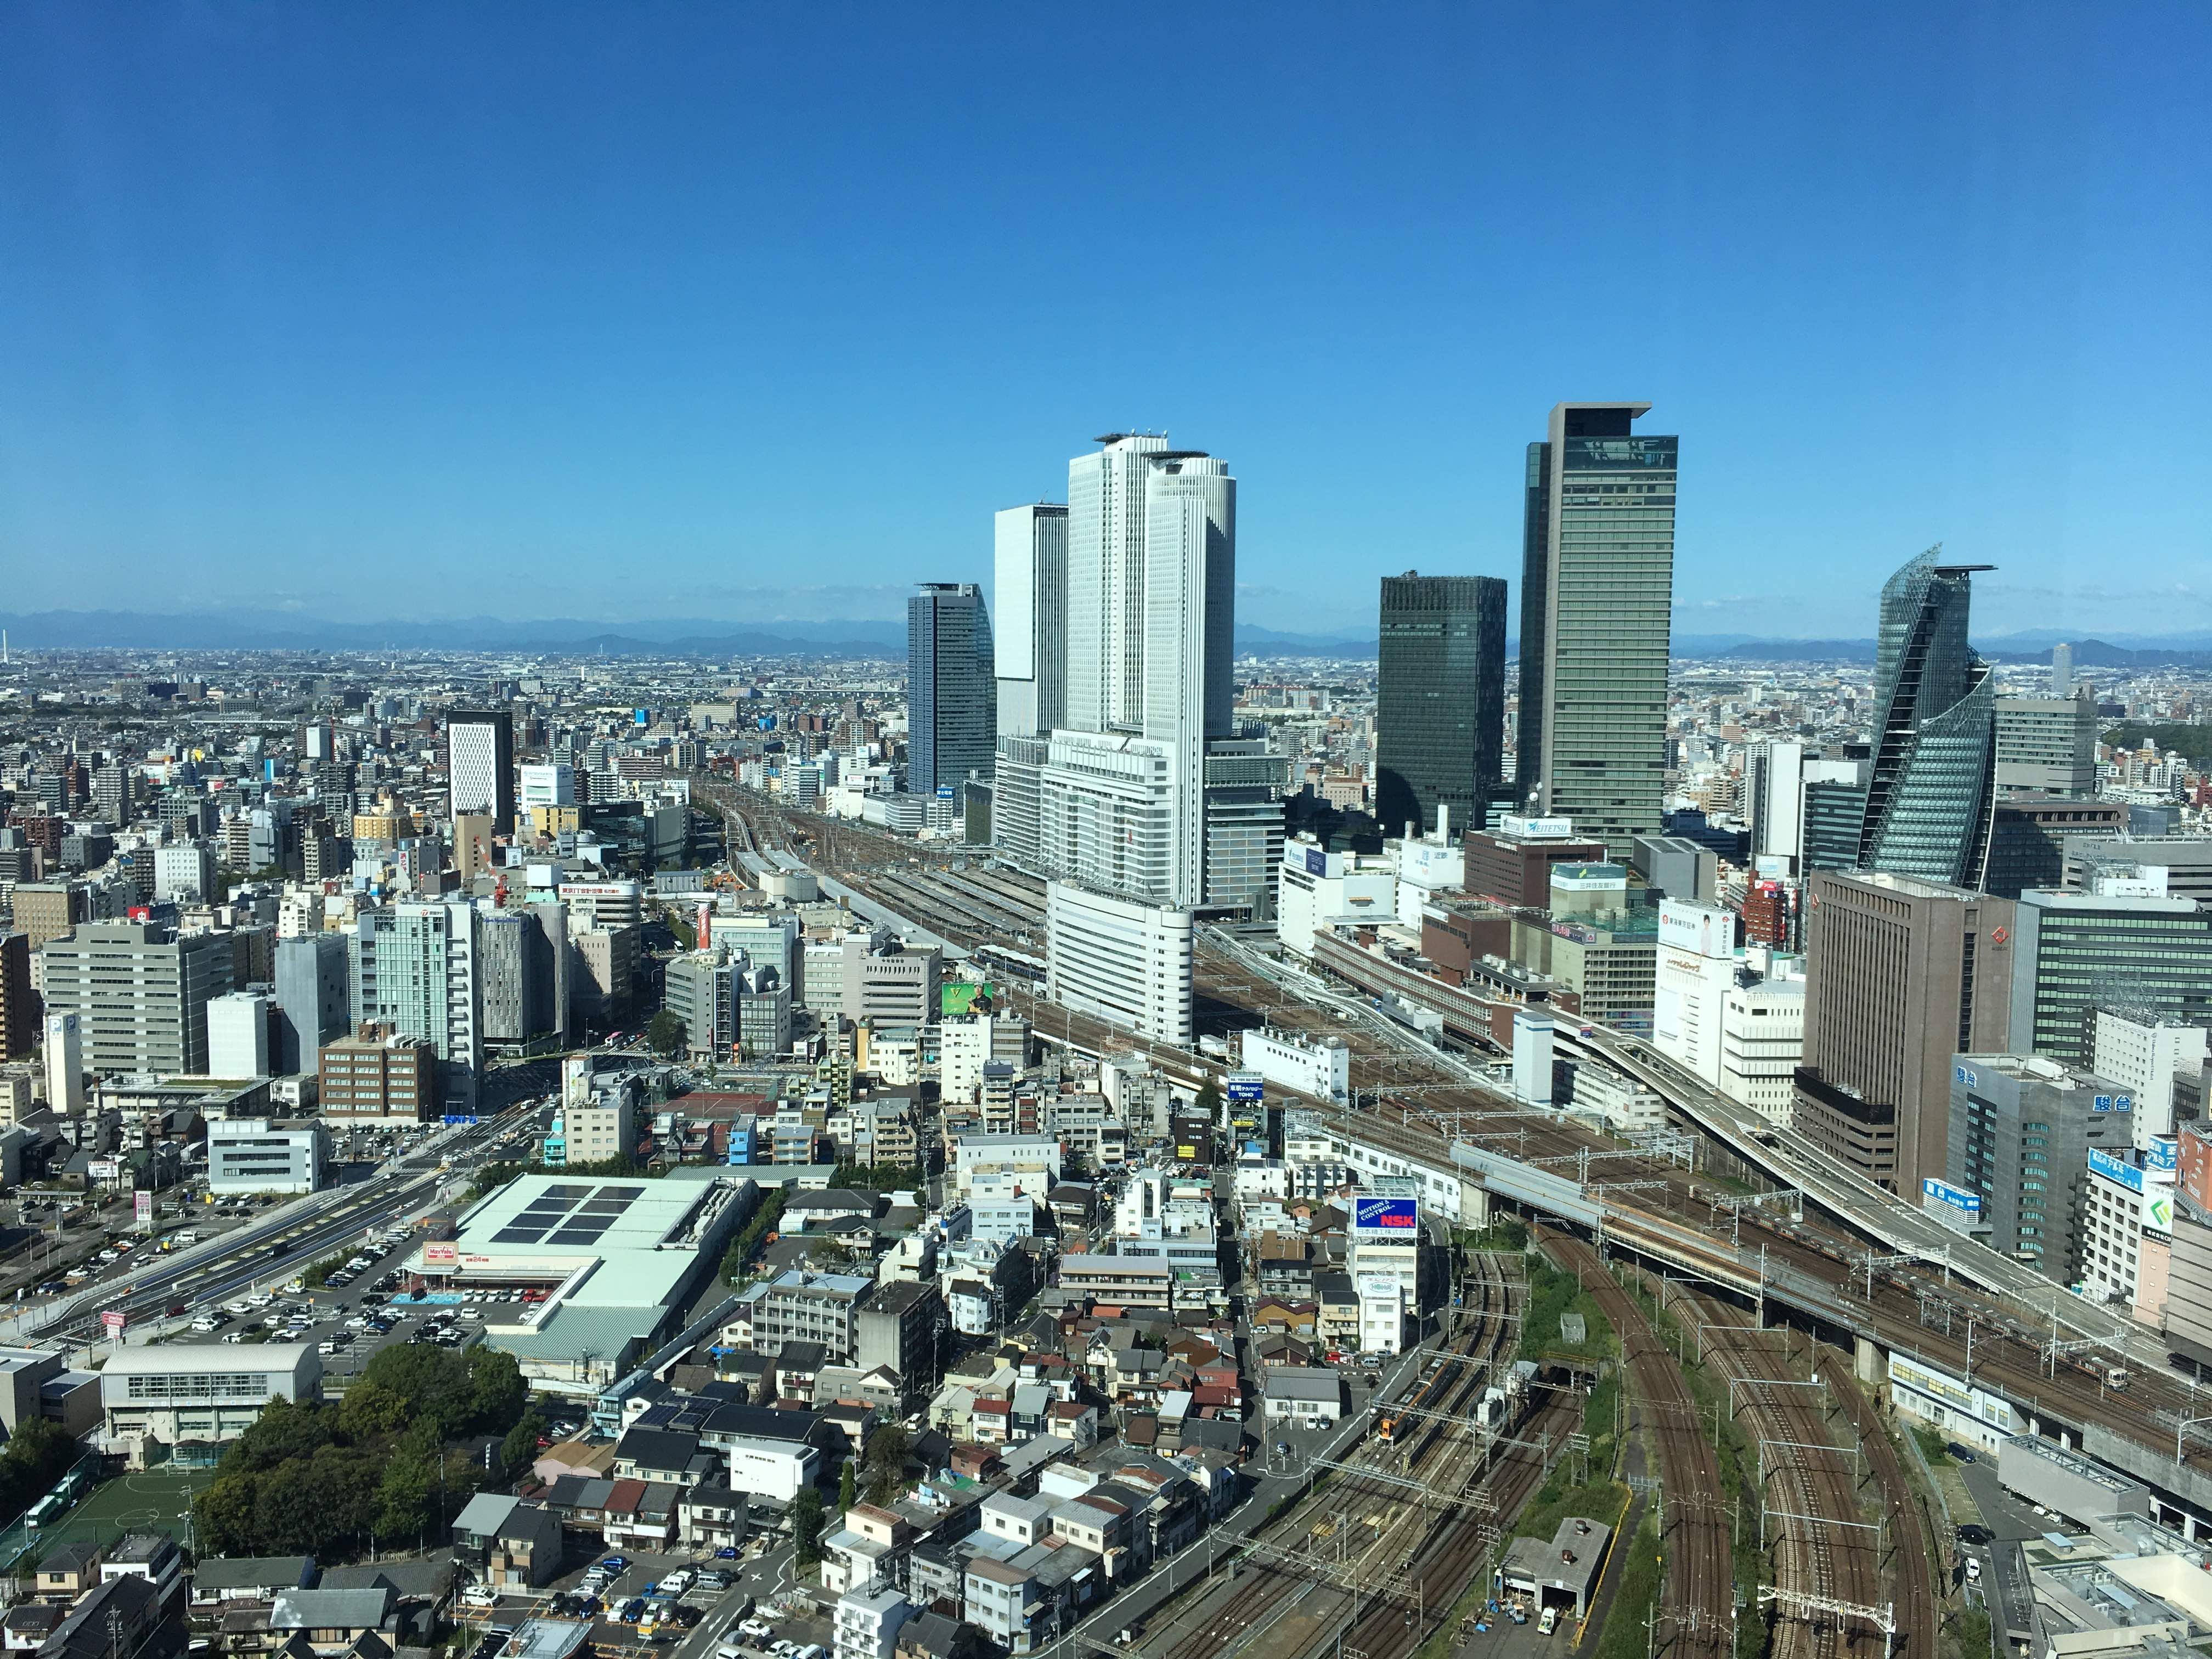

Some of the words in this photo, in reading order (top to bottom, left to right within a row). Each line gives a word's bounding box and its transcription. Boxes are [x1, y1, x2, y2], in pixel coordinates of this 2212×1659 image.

[1527, 821, 1568, 832] MEITETSU
[50, 1019, 60, 1031] P
[67, 1017, 75, 1030] P
[1957, 1066, 1977, 1088] 駿台
[2093, 1095, 2131, 1112] 駿台
[2147, 1151, 2165, 1166] アルミ
[1926, 1181, 1945, 1199] 駿台
[1358, 1200, 1385, 1216] MOTION
[1361, 1205, 1392, 1221] CONTROL
[1380, 1215, 1415, 1227] NSK
[430, 1245, 452, 1255] MaxValu
